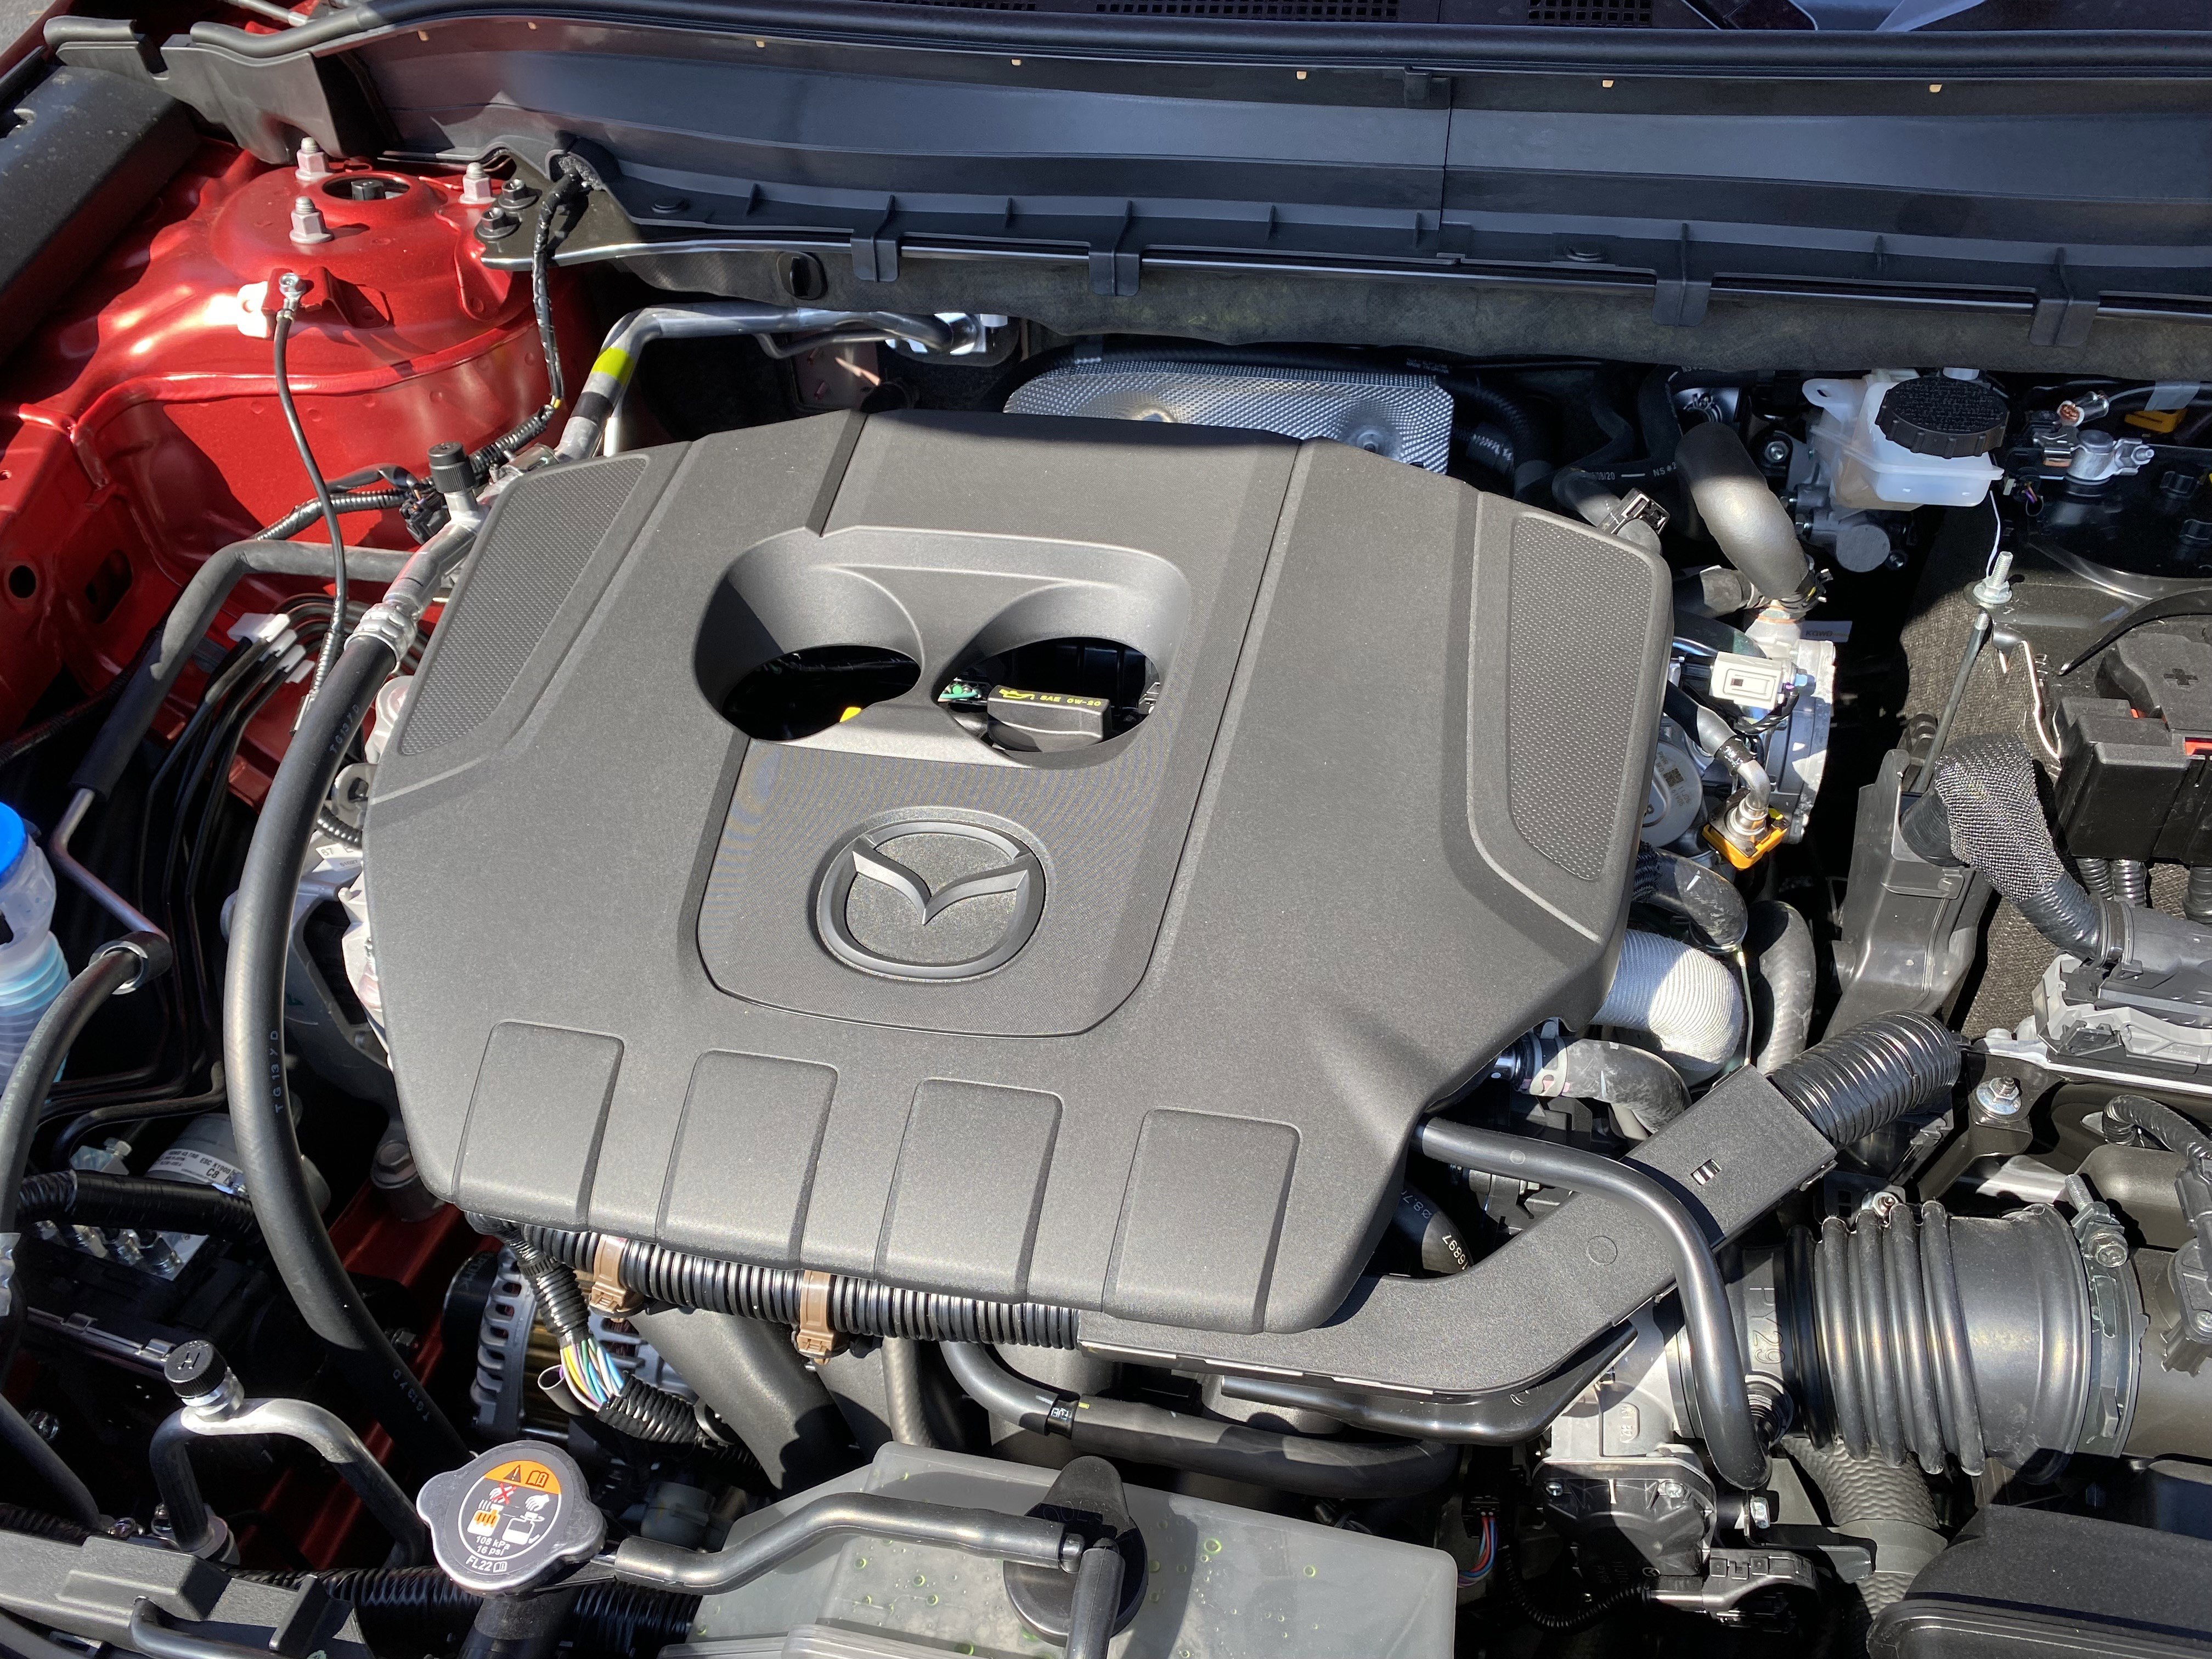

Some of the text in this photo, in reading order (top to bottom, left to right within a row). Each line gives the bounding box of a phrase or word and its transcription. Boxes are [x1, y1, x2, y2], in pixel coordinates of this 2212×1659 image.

[200, 1158, 212, 1166] ESC
[206, 1168, 219, 1178] C8
[476, 1536, 511, 1550] 108 kPa
[477, 1545, 505, 1556] 16 psi
[465, 1555, 493, 1572] FL22
